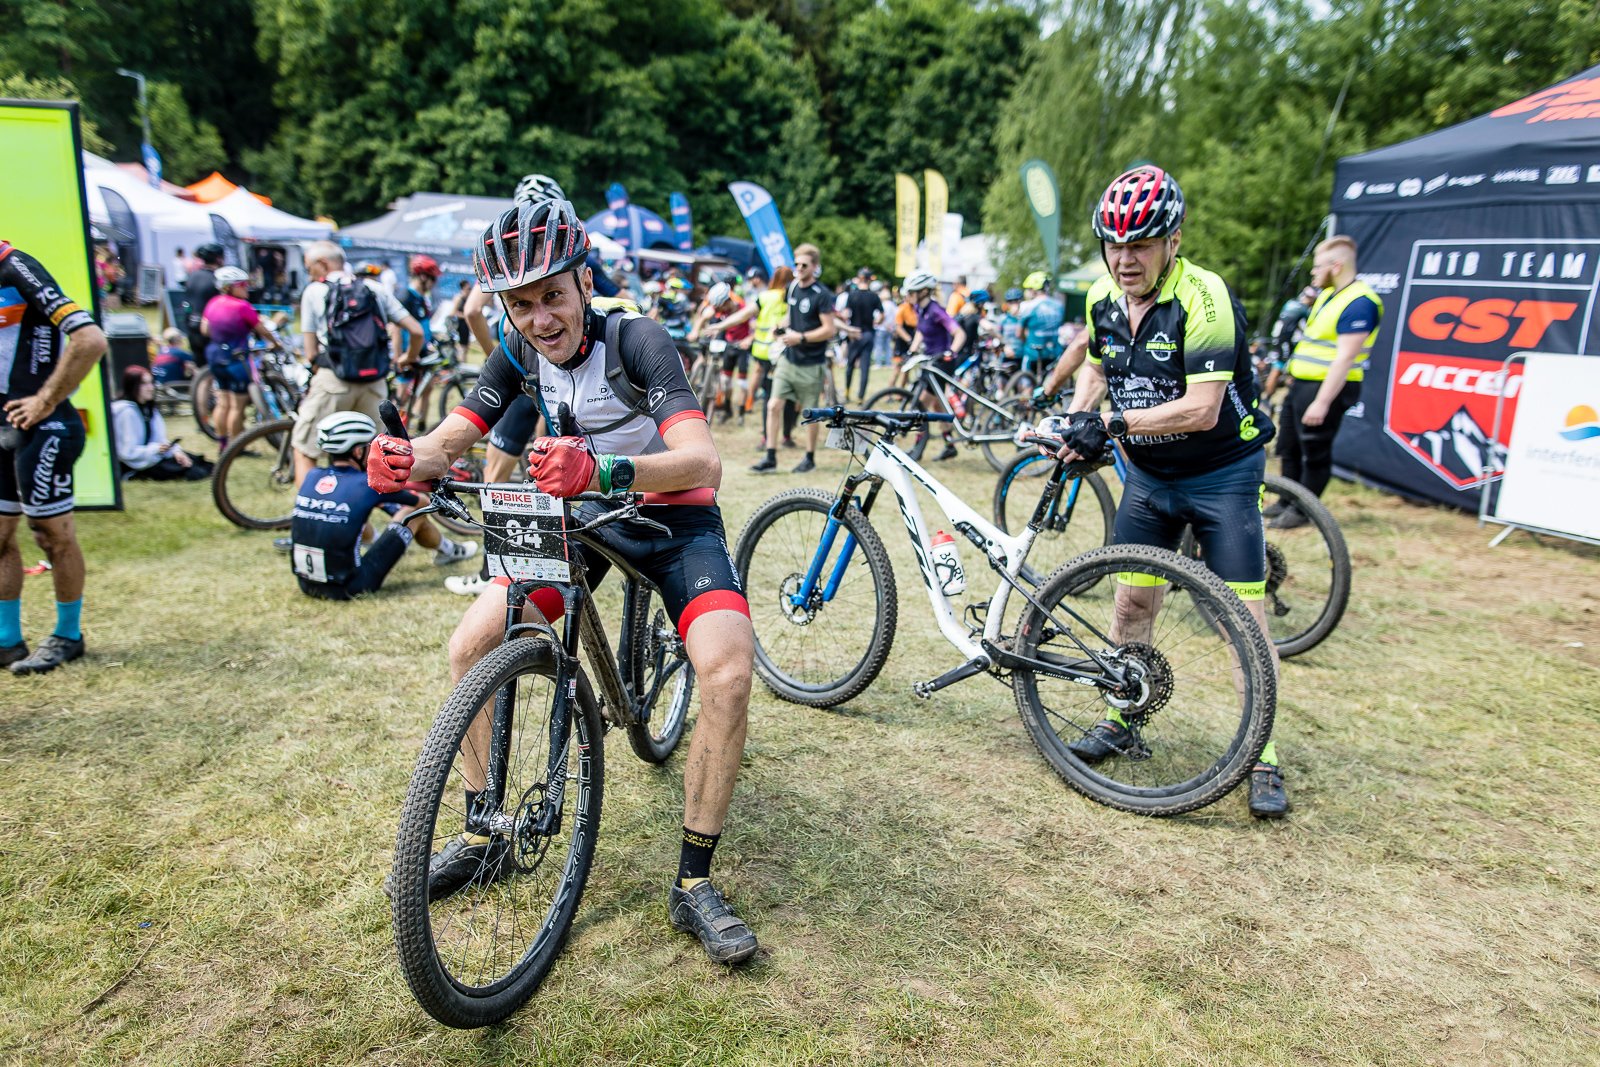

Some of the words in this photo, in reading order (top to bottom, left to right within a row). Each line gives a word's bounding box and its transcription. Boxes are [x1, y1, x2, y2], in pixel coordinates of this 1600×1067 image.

[1421, 251, 1480, 276] MTB
[1502, 251, 1586, 278] TEAM
[1408, 296, 1578, 348] CST
[503, 494, 532, 503] BIKE
[506, 519, 542, 549] 94
[306, 554, 314, 574] 9
